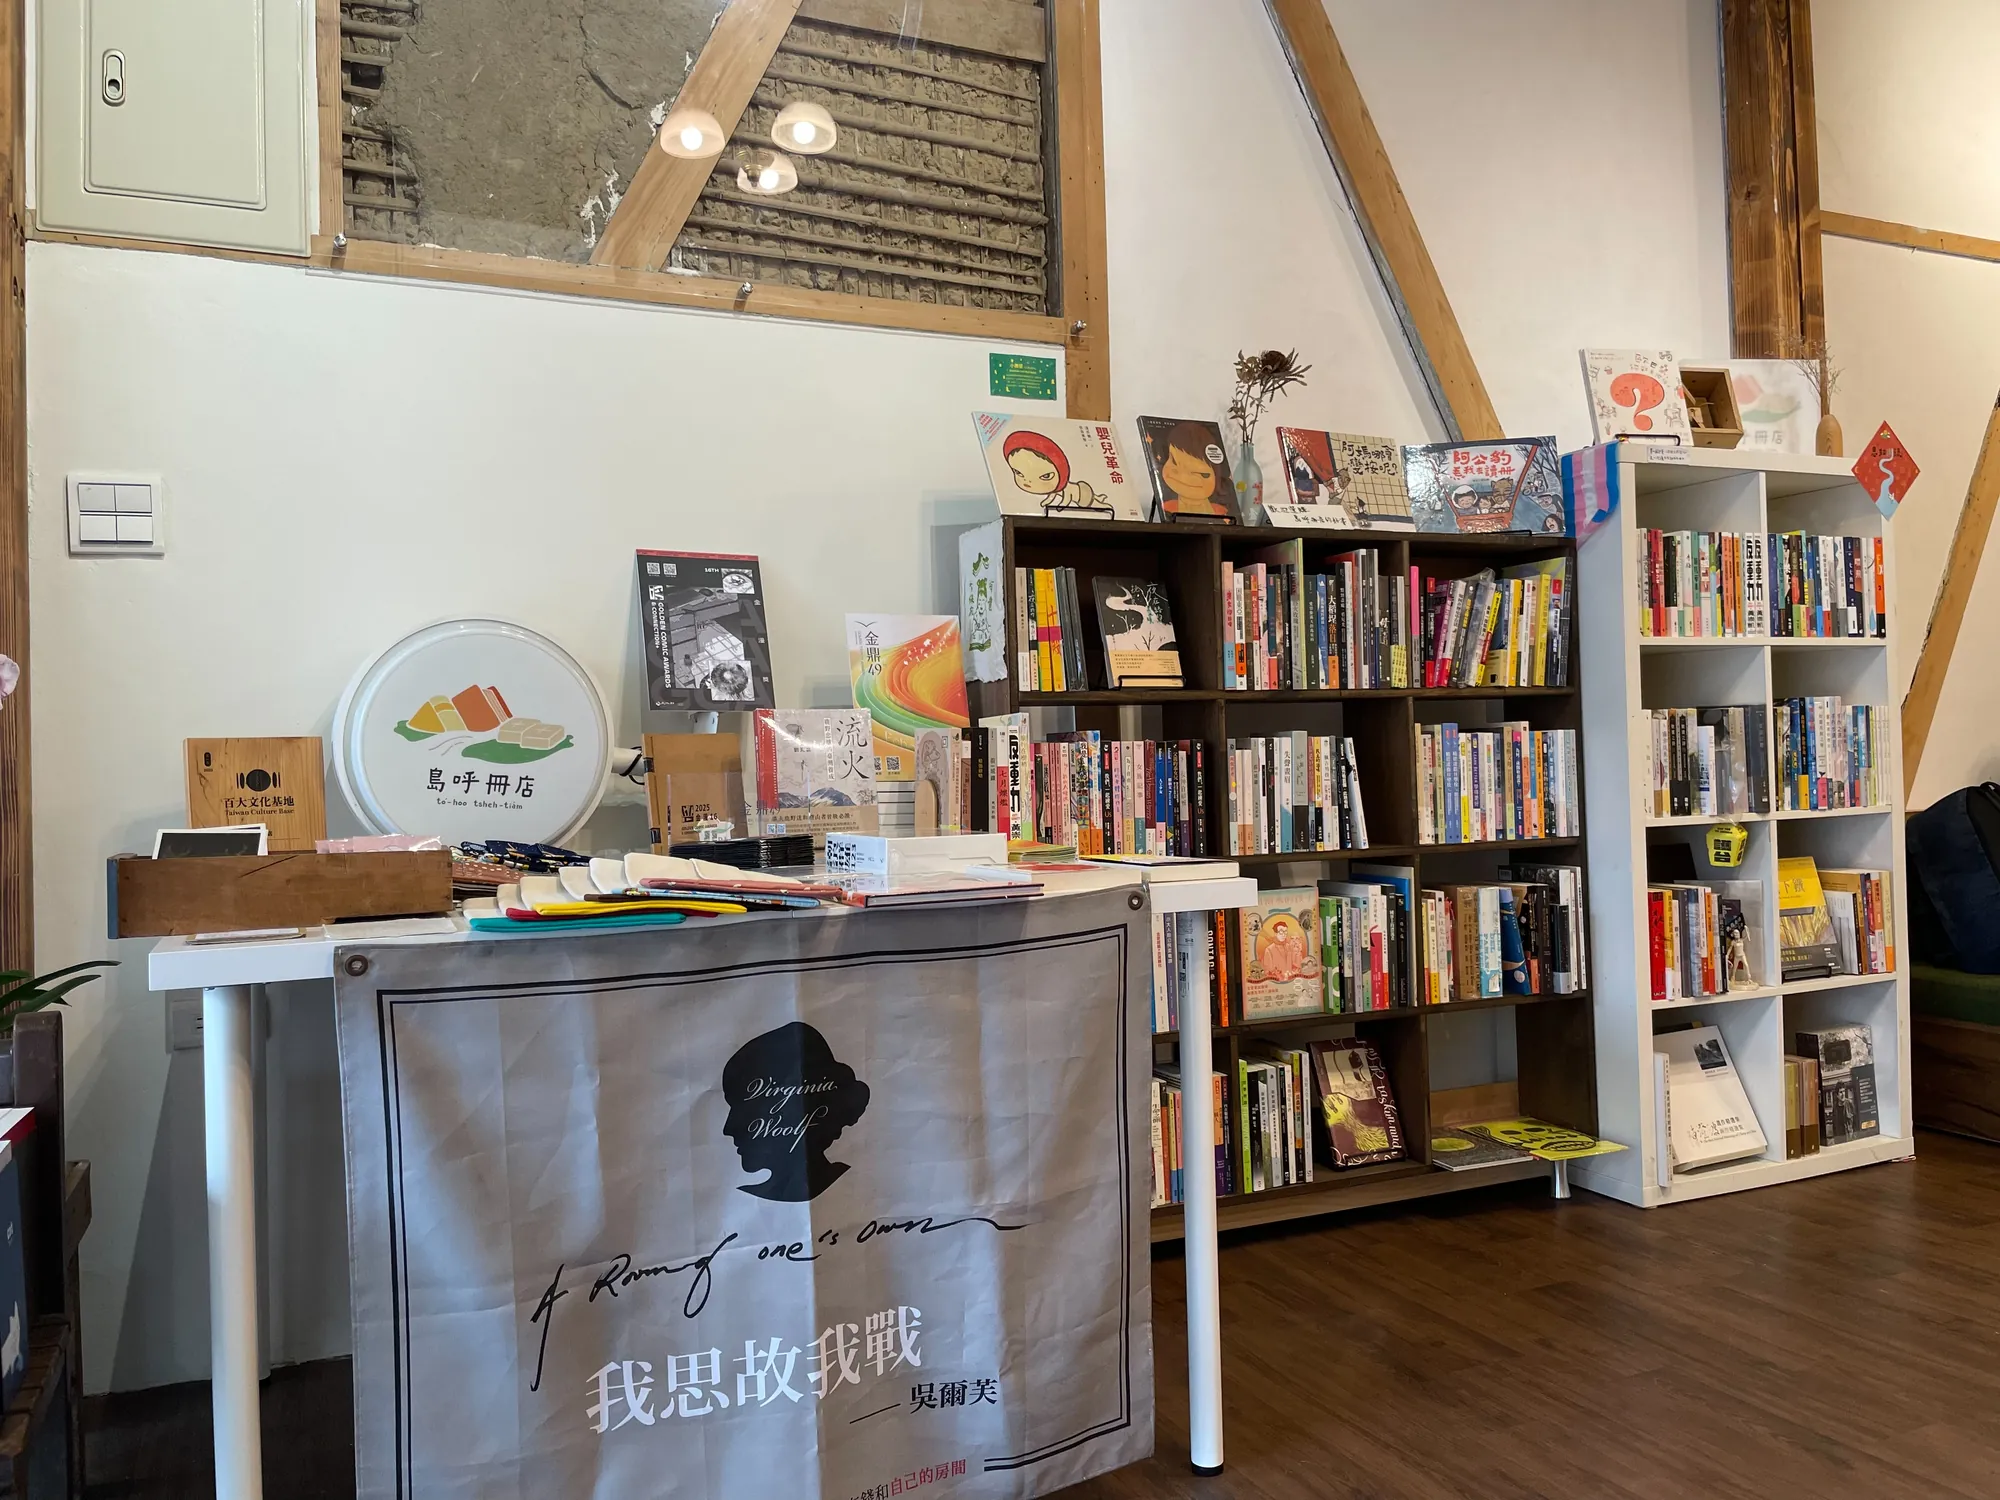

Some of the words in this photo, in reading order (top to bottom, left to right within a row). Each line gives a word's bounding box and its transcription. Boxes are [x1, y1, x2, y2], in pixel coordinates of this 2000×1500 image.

[1095, 426, 1124, 485] 嬰兒革命
[1453, 449, 1512, 465] 阿公豹
[658, 602, 667, 631] GOLDEN
[660, 631, 669, 656] COMIC
[864, 630, 882, 676] 金鼎49
[662, 656, 672, 689] AWARDS
[836, 716, 870, 779] 流火
[427, 767, 535, 798] 島呼冊店
[224, 796, 295, 808] 百大文化基地
[225, 808, 250, 816] Taiwan
[250, 808, 277, 816] Culture
[695, 803, 711, 812] 2025
[744, 1076, 838, 1114] Virginia
[747, 1105, 829, 1153] Woolf
[529, 1263, 569, 1393] A
[585, 1305, 922, 1435] 我思故我戰
[909, 1378, 998, 1414] 吳爾芙
[849, 1459, 966, 1500] 錢和自己的房間
